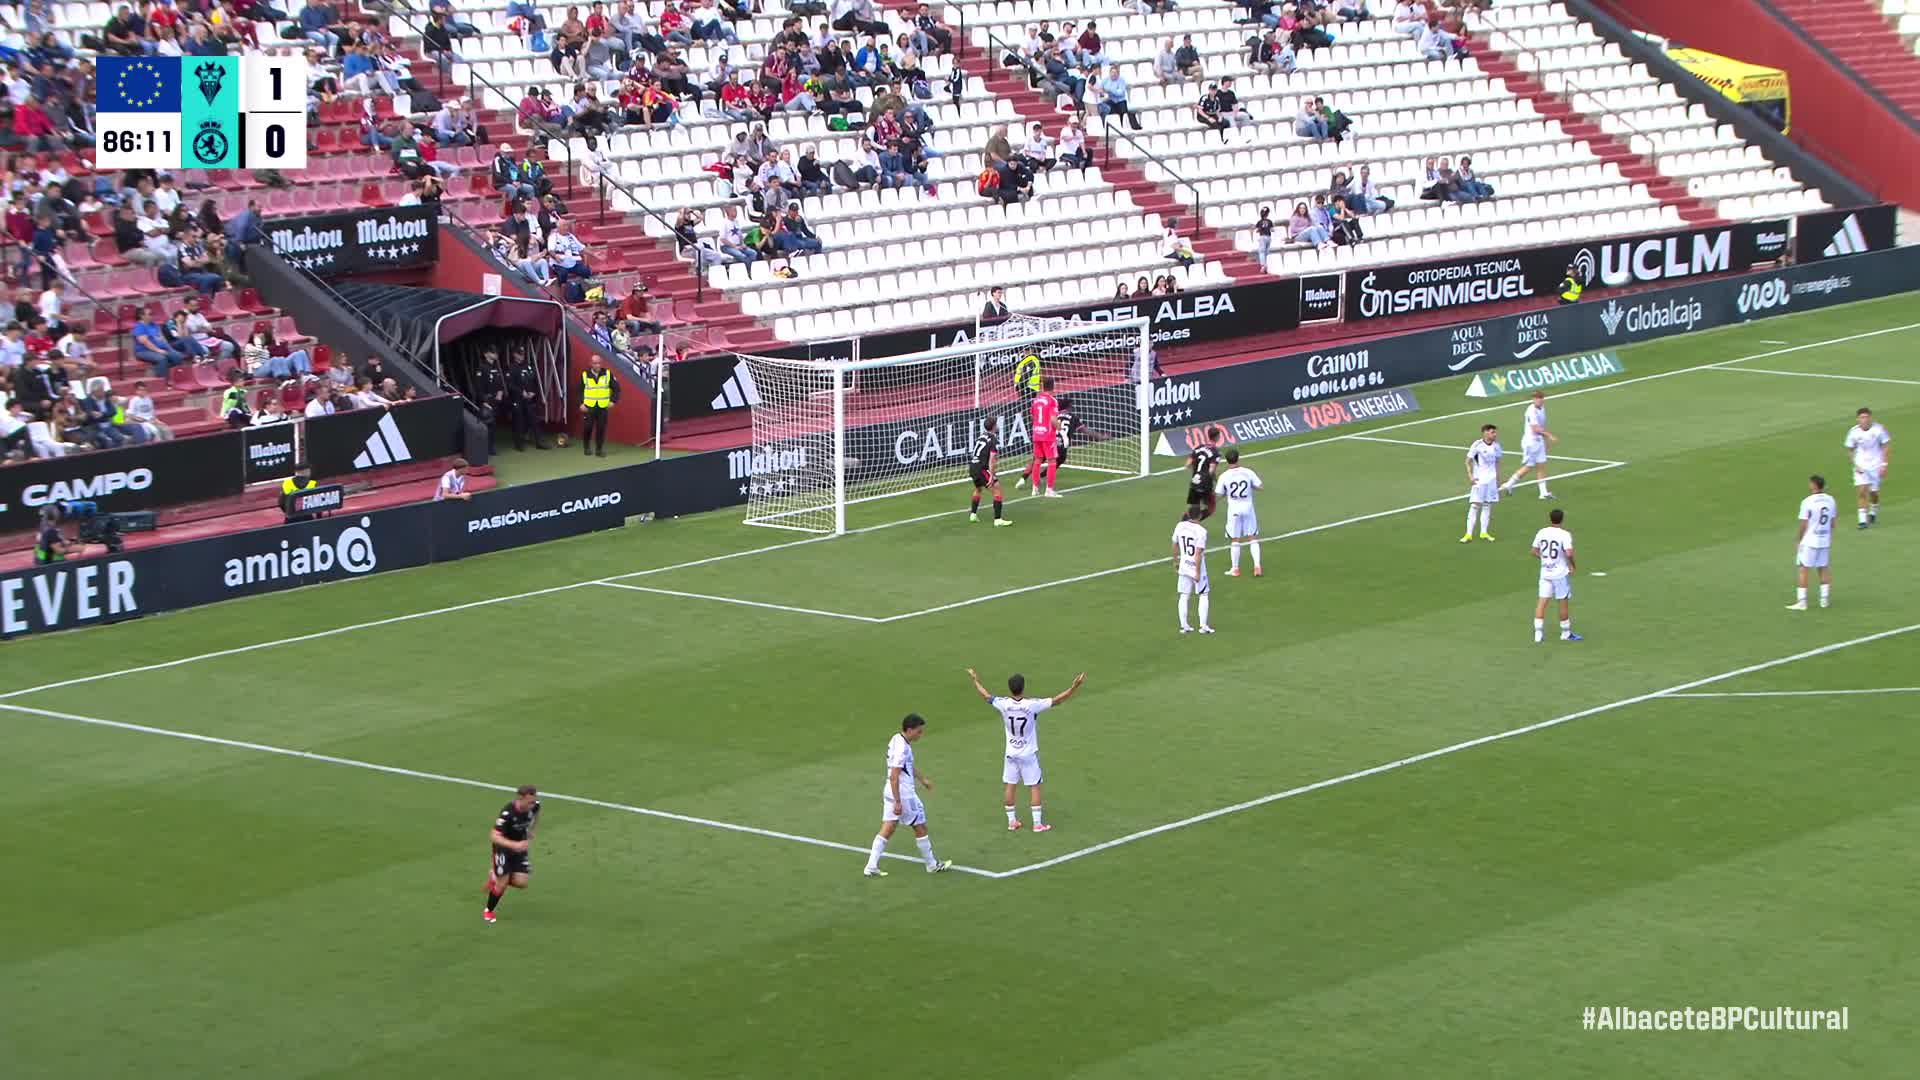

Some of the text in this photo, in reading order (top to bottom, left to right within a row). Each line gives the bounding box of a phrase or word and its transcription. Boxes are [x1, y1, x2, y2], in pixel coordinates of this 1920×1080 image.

[271, 226, 345, 254] Mahou
[356, 215, 428, 244] Mahou
[1601, 230, 1731, 285] UCLM
[1408, 259, 1521, 285] ORTOPEDIA TECNICA
[1394, 275, 1534, 312] SANMIGUEL
[1154, 293, 1235, 323] ALBA
[1517, 314, 1549, 329] AQUA
[1626, 297, 1701, 332] Globalcaja
[1451, 325, 1484, 341] AQUA
[1518, 328, 1547, 344] DEUS
[1452, 340, 1483, 356] DEUS
[1307, 350, 1369, 378] Canon
[1507, 352, 1616, 390] GLOBALCAJA
[1037, 406, 1043, 424] 1
[1350, 392, 1409, 419] ENERGÍA
[1234, 411, 1296, 440] ENERGÍA
[1198, 455, 1208, 472] 7
[22, 468, 153, 507] CAMPO
[1229, 480, 1248, 499] 22
[468, 508, 530, 533] PASIÓN
[531, 511, 549, 521] POR
[561, 492, 622, 514] CAMPO
[1819, 506, 1829, 525] 6
[1181, 535, 1196, 557] 15
[1540, 539, 1559, 560] 26
[0, 560, 138, 634] EVER
[1008, 716, 1028, 737] 17
